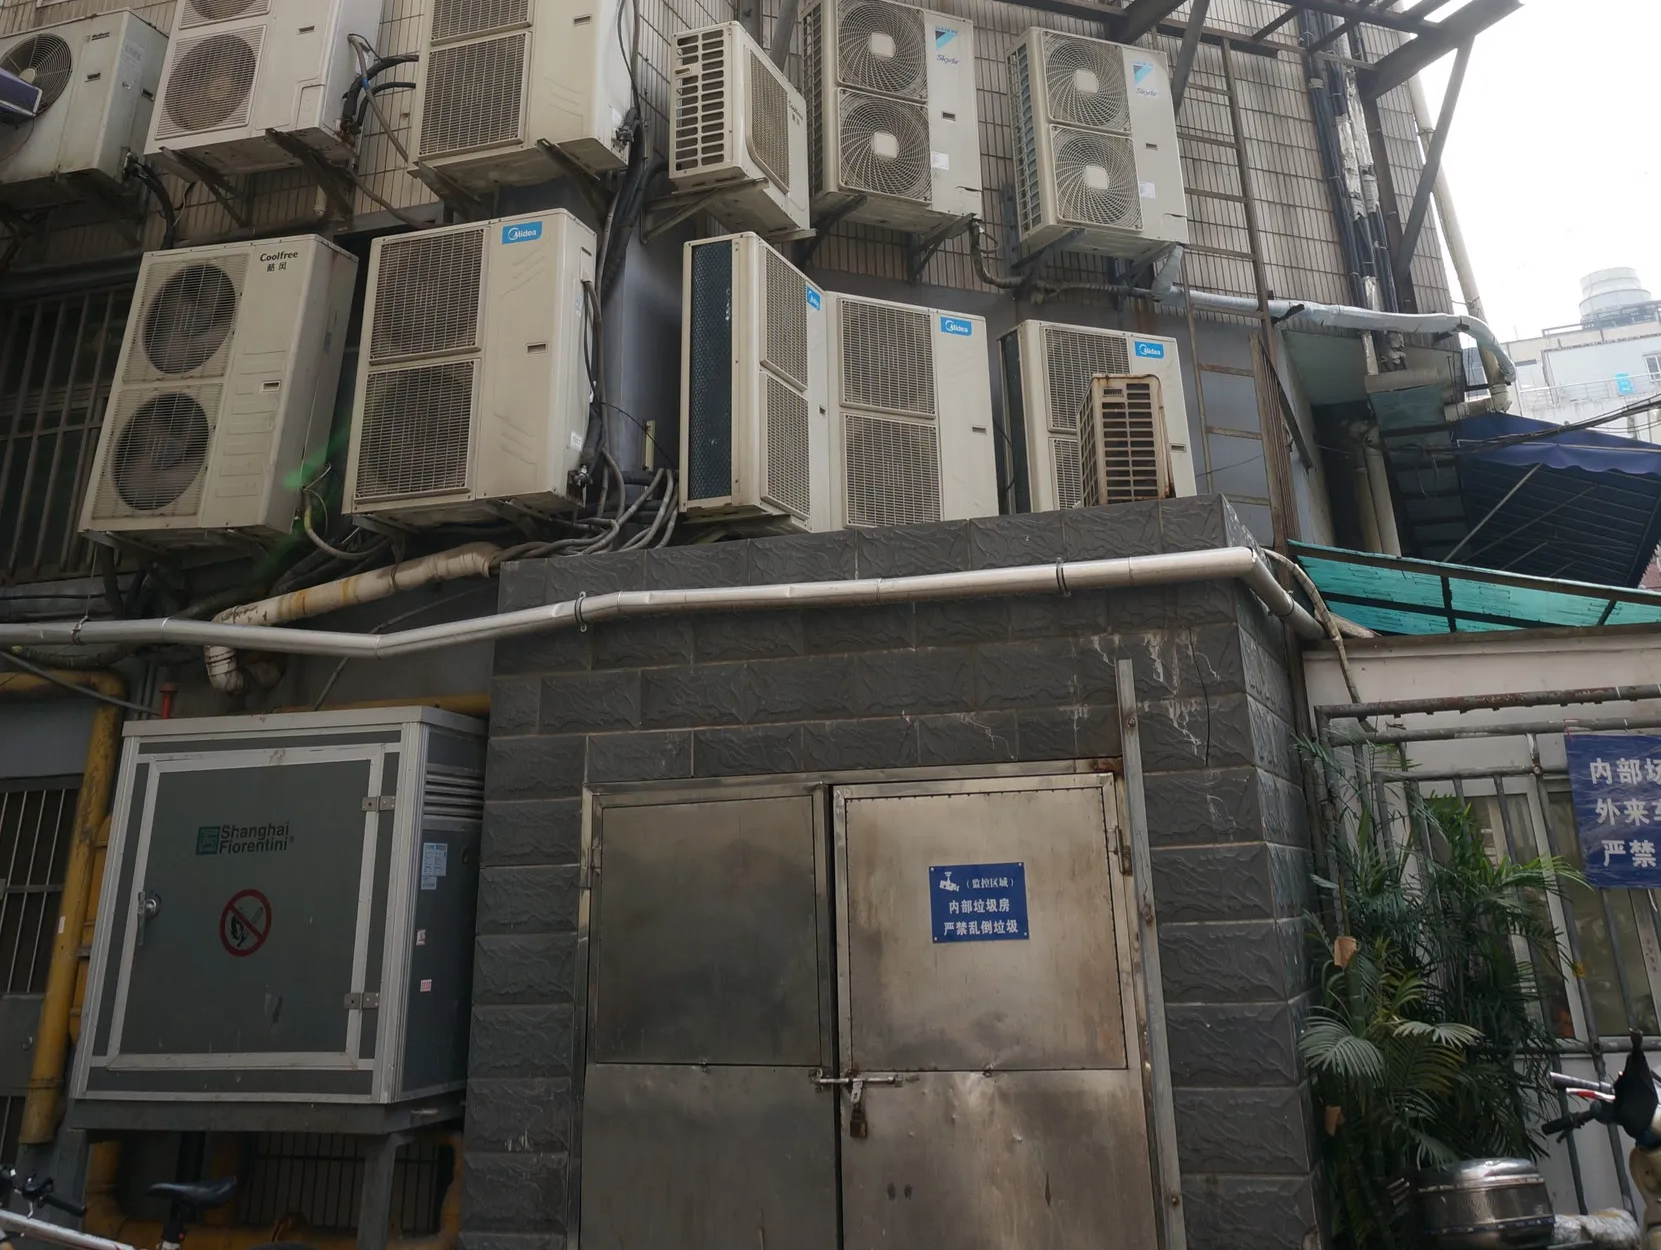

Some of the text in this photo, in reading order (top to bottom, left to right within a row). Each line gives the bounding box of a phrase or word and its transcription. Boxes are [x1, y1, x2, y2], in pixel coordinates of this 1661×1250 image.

[508, 227, 537, 240] Midea
[260, 250, 299, 262] Coolfree
[945, 320, 969, 333] Midea
[1139, 343, 1161, 356] Midea
[221, 822, 290, 840] Shanghai
[219, 837, 288, 855] Fiorentini
[1601, 839, 1657, 868] 严禁
[949, 897, 1010, 914] 内部垃圾房
[943, 918, 1019, 937] 严禁乱倒垃圾
